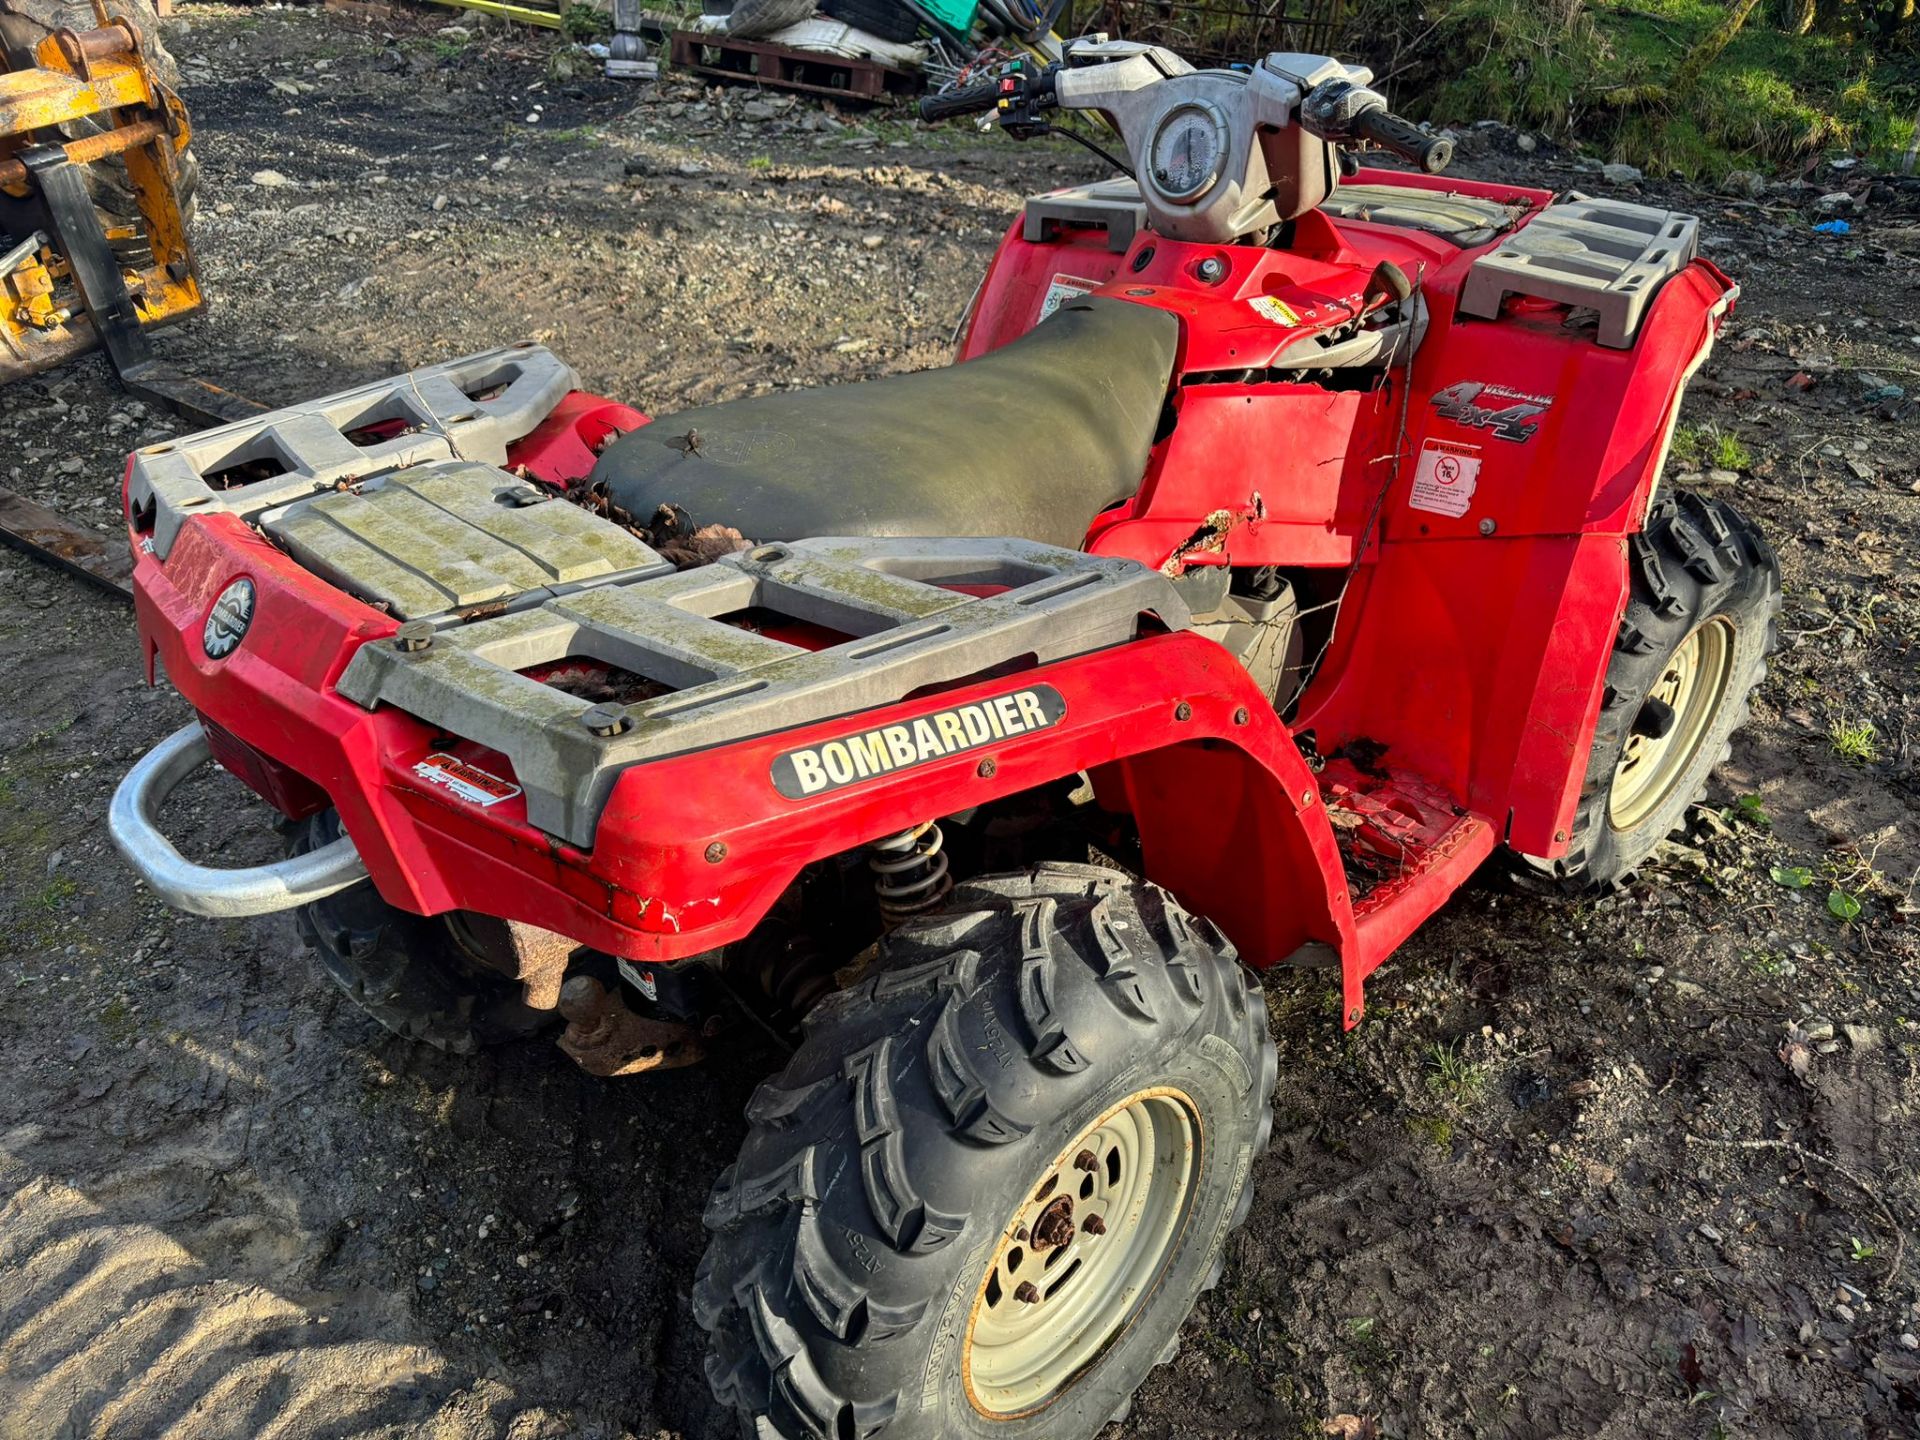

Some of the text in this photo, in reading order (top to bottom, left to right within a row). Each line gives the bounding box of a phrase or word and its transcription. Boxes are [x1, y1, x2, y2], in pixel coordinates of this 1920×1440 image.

[1304, 310, 1317, 318] P
[1440, 444, 1473, 456] WARNING
[1442, 470, 1452, 479] 16
[790, 691, 1048, 795] BOMBARDIER
